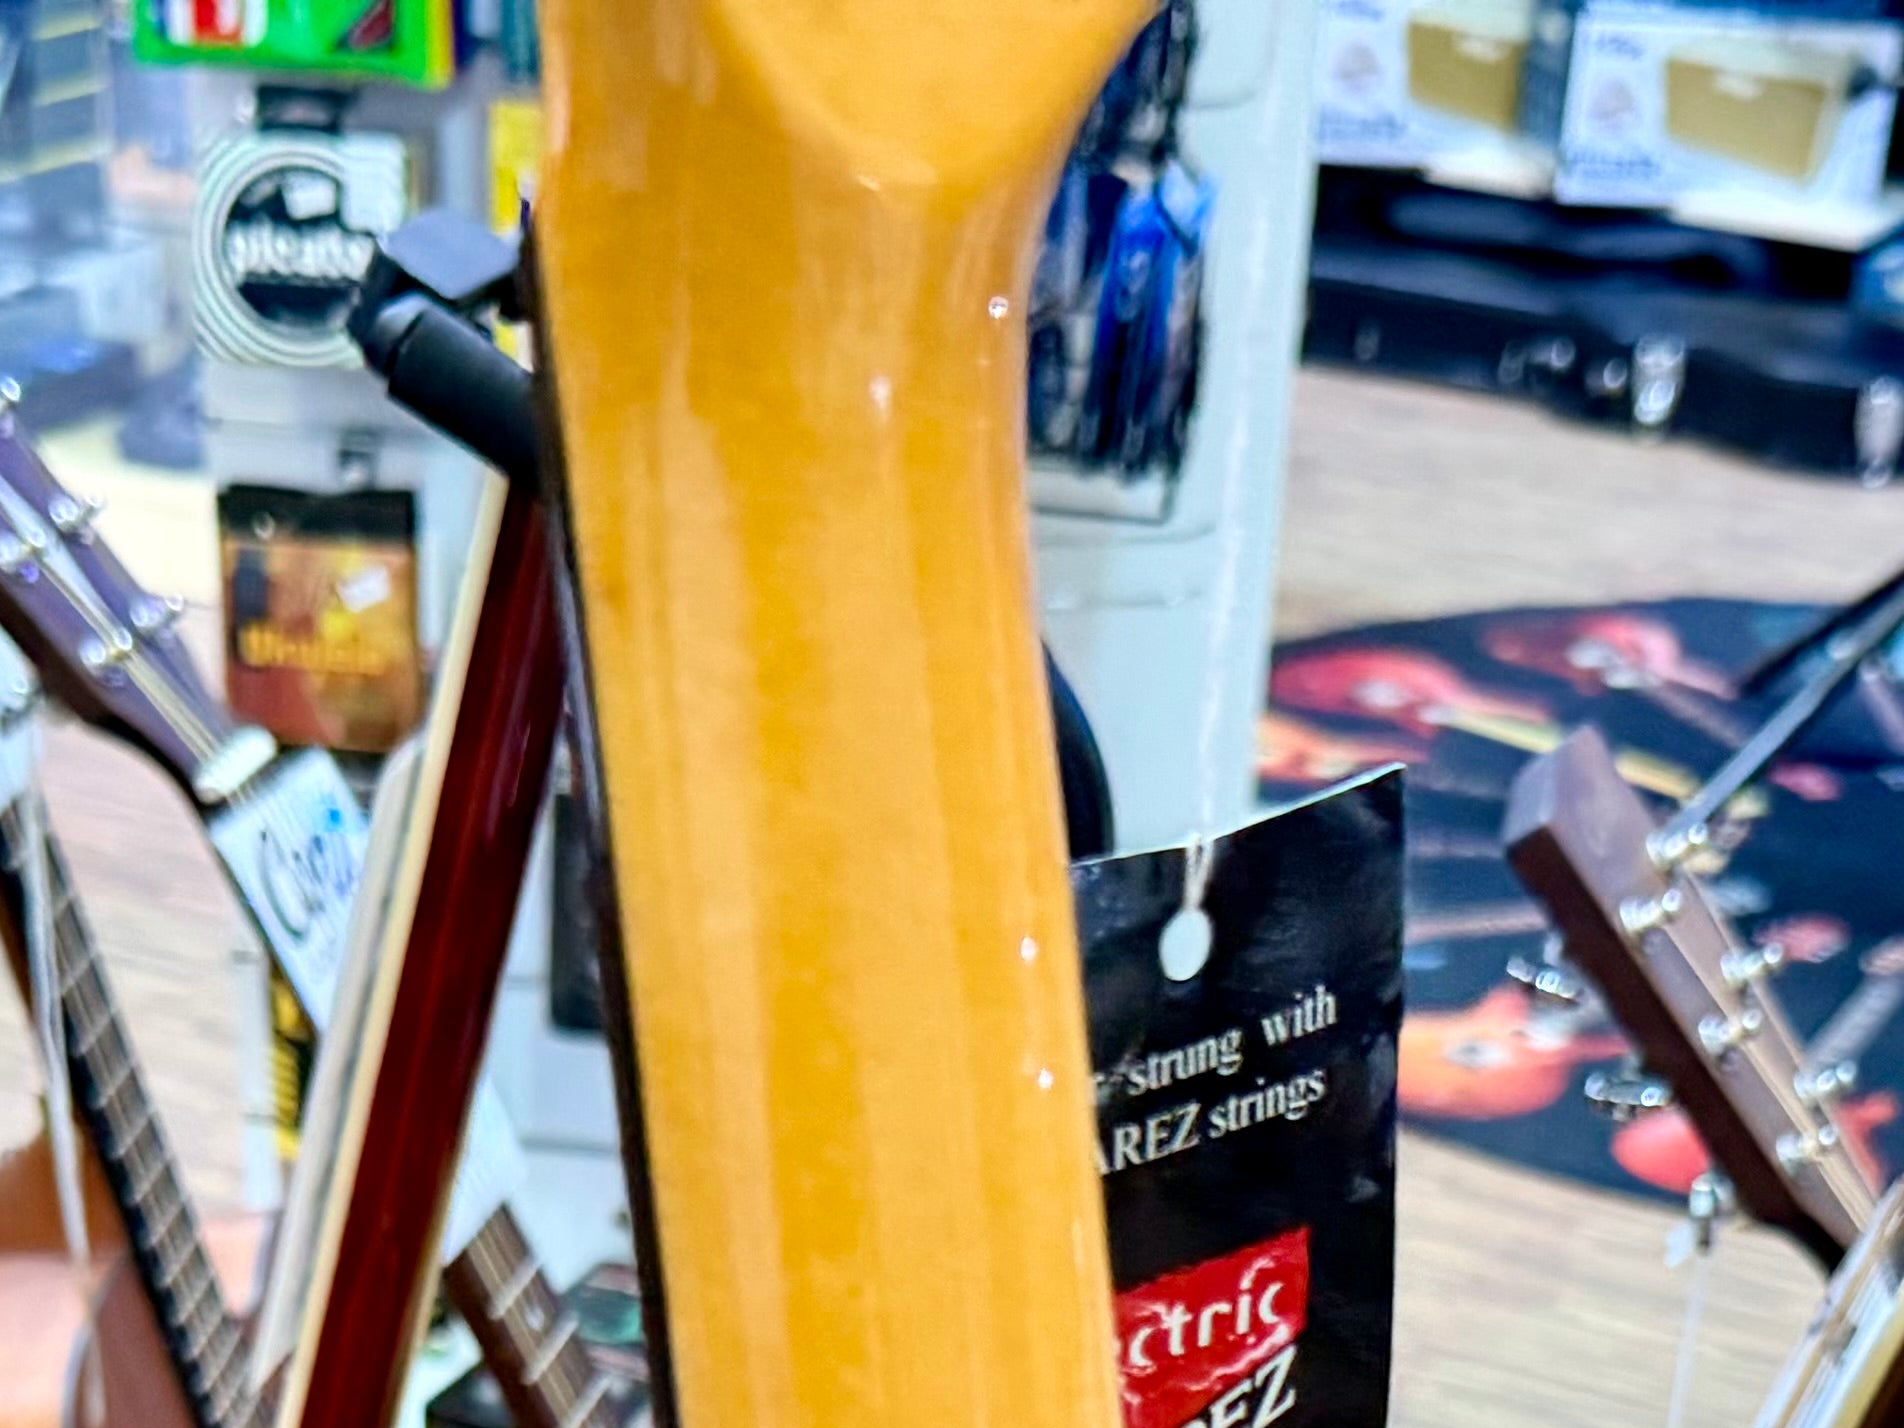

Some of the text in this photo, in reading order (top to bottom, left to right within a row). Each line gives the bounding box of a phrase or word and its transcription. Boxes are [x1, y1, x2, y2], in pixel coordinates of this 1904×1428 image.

[1127, 1028, 1244, 1097] strung
[1261, 983, 1339, 1047] with
[1208, 1068, 1327, 1140] strings
[1128, 1256, 1285, 1368] ctric
